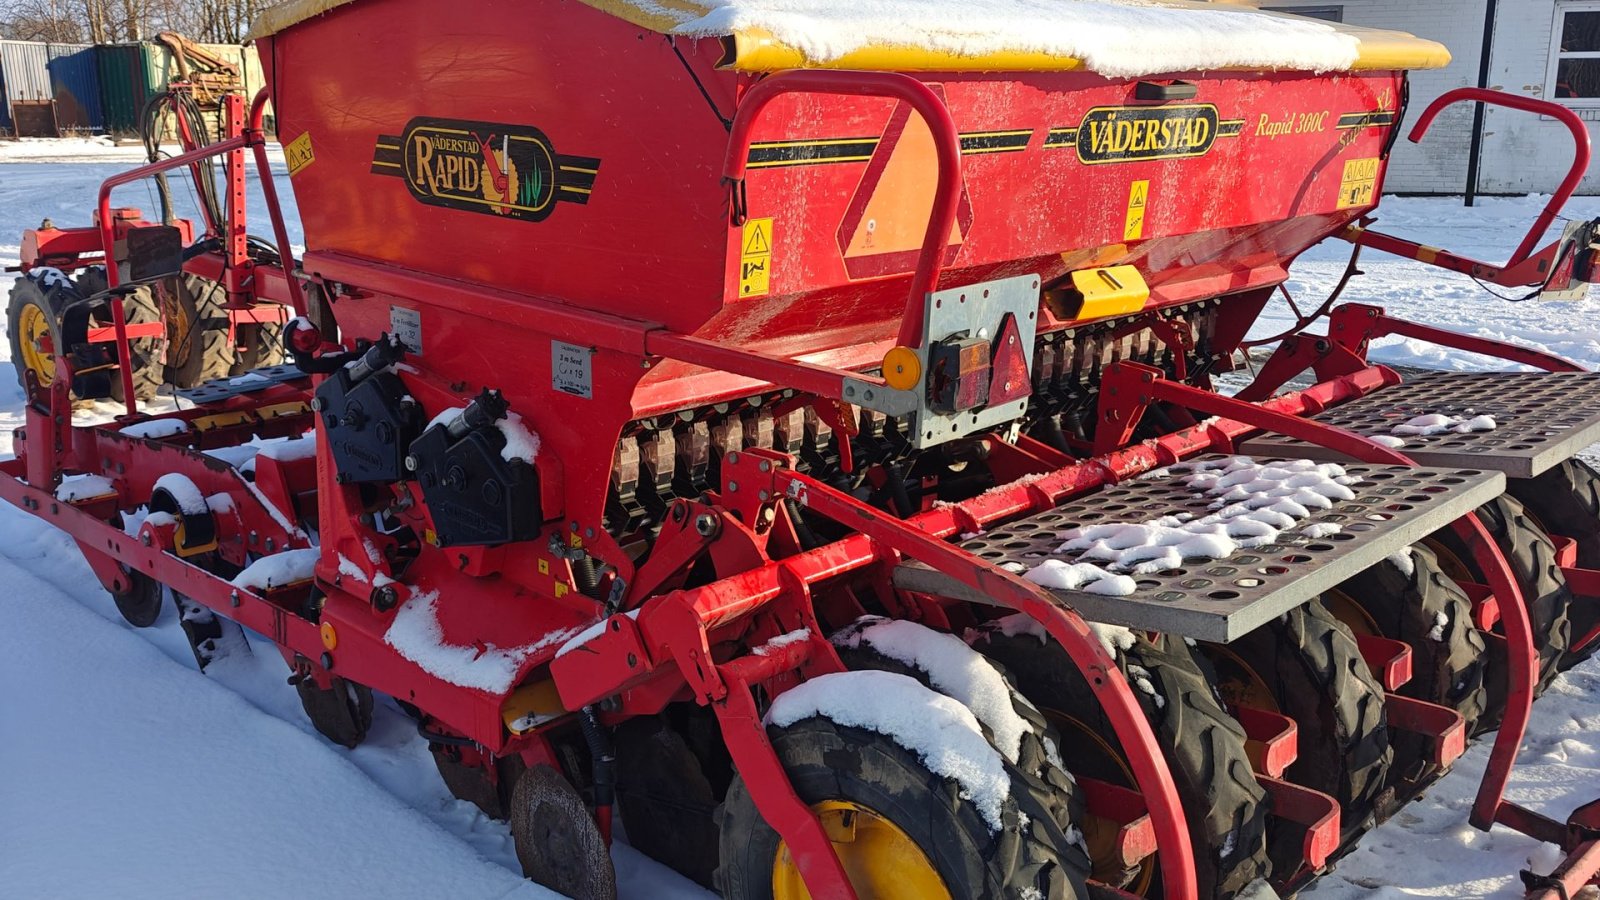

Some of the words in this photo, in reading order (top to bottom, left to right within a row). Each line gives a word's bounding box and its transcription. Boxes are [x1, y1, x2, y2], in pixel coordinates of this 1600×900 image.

[1376, 87, 1392, 115] XL
[1090, 113, 1209, 153] VÄDERSTAD
[1255, 113, 1296, 140] Rapid
[1296, 111, 1329, 133] 300C
[430, 135, 479, 154] VÄDERSTAD
[575, 370, 583, 379] 19
